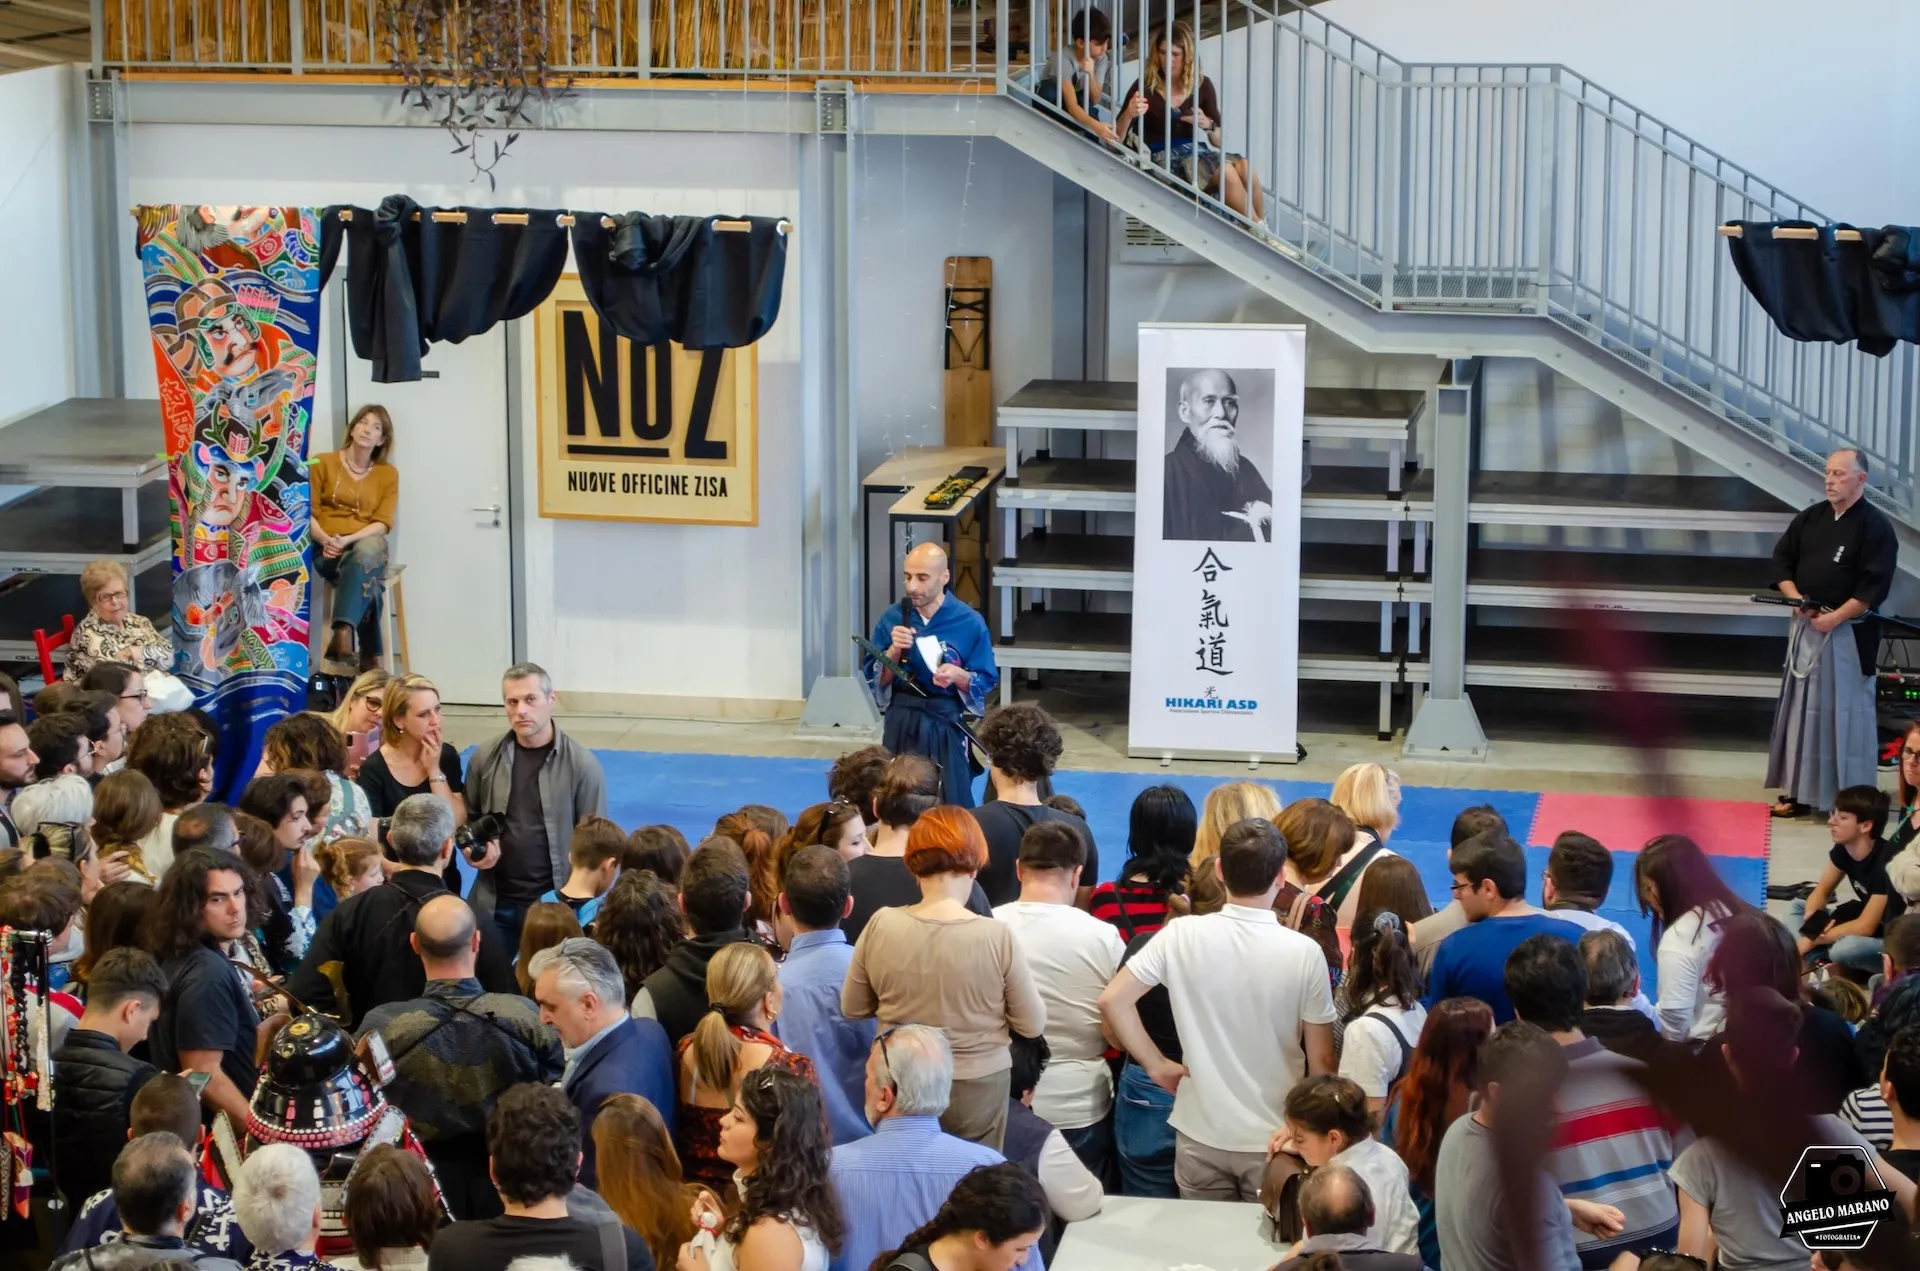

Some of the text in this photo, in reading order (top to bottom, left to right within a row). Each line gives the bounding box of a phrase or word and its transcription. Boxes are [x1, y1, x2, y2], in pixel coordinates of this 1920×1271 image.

[622, 472, 689, 496] OFFICINE
[694, 475, 728, 497] ZISA
[1165, 698, 1258, 710] HIKARI ASD
